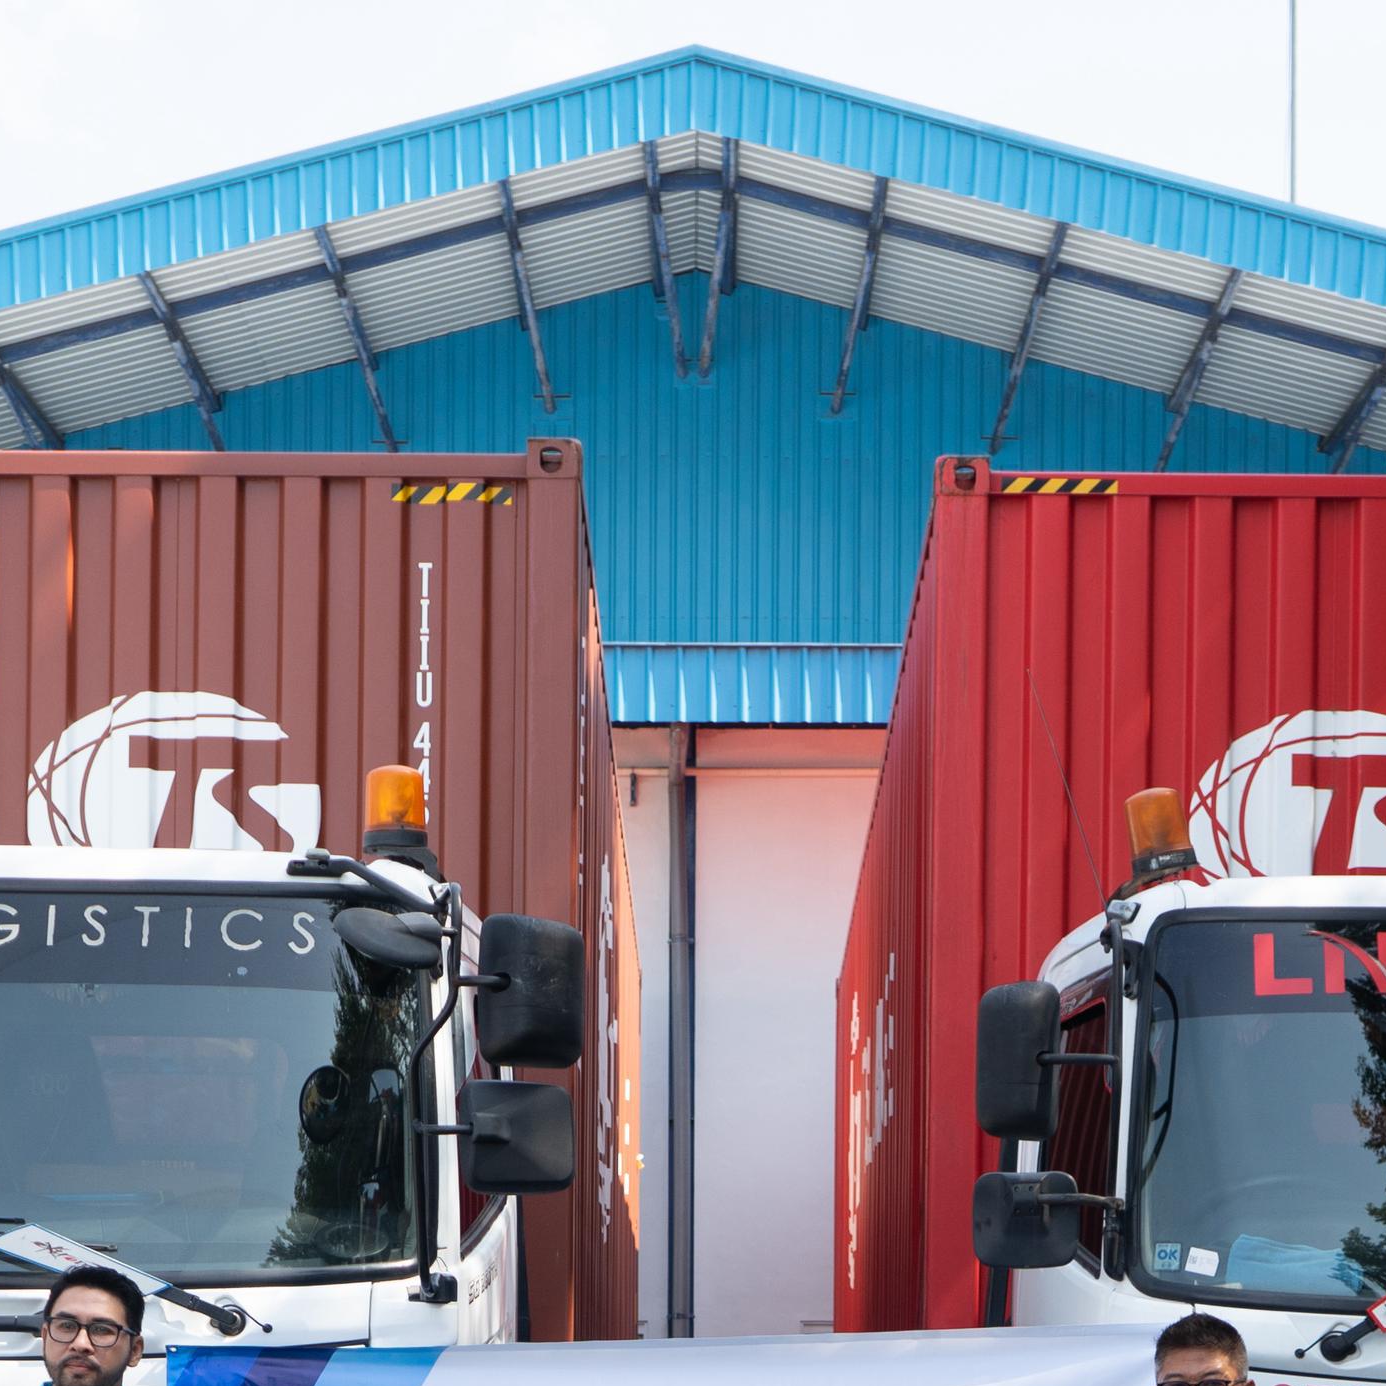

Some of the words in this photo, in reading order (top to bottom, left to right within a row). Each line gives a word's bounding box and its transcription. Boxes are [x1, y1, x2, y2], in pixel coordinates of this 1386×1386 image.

[416, 562, 433, 707] TIIU
[413, 722, 431, 824] 44
[1157, 1249, 1178, 1261] OK
